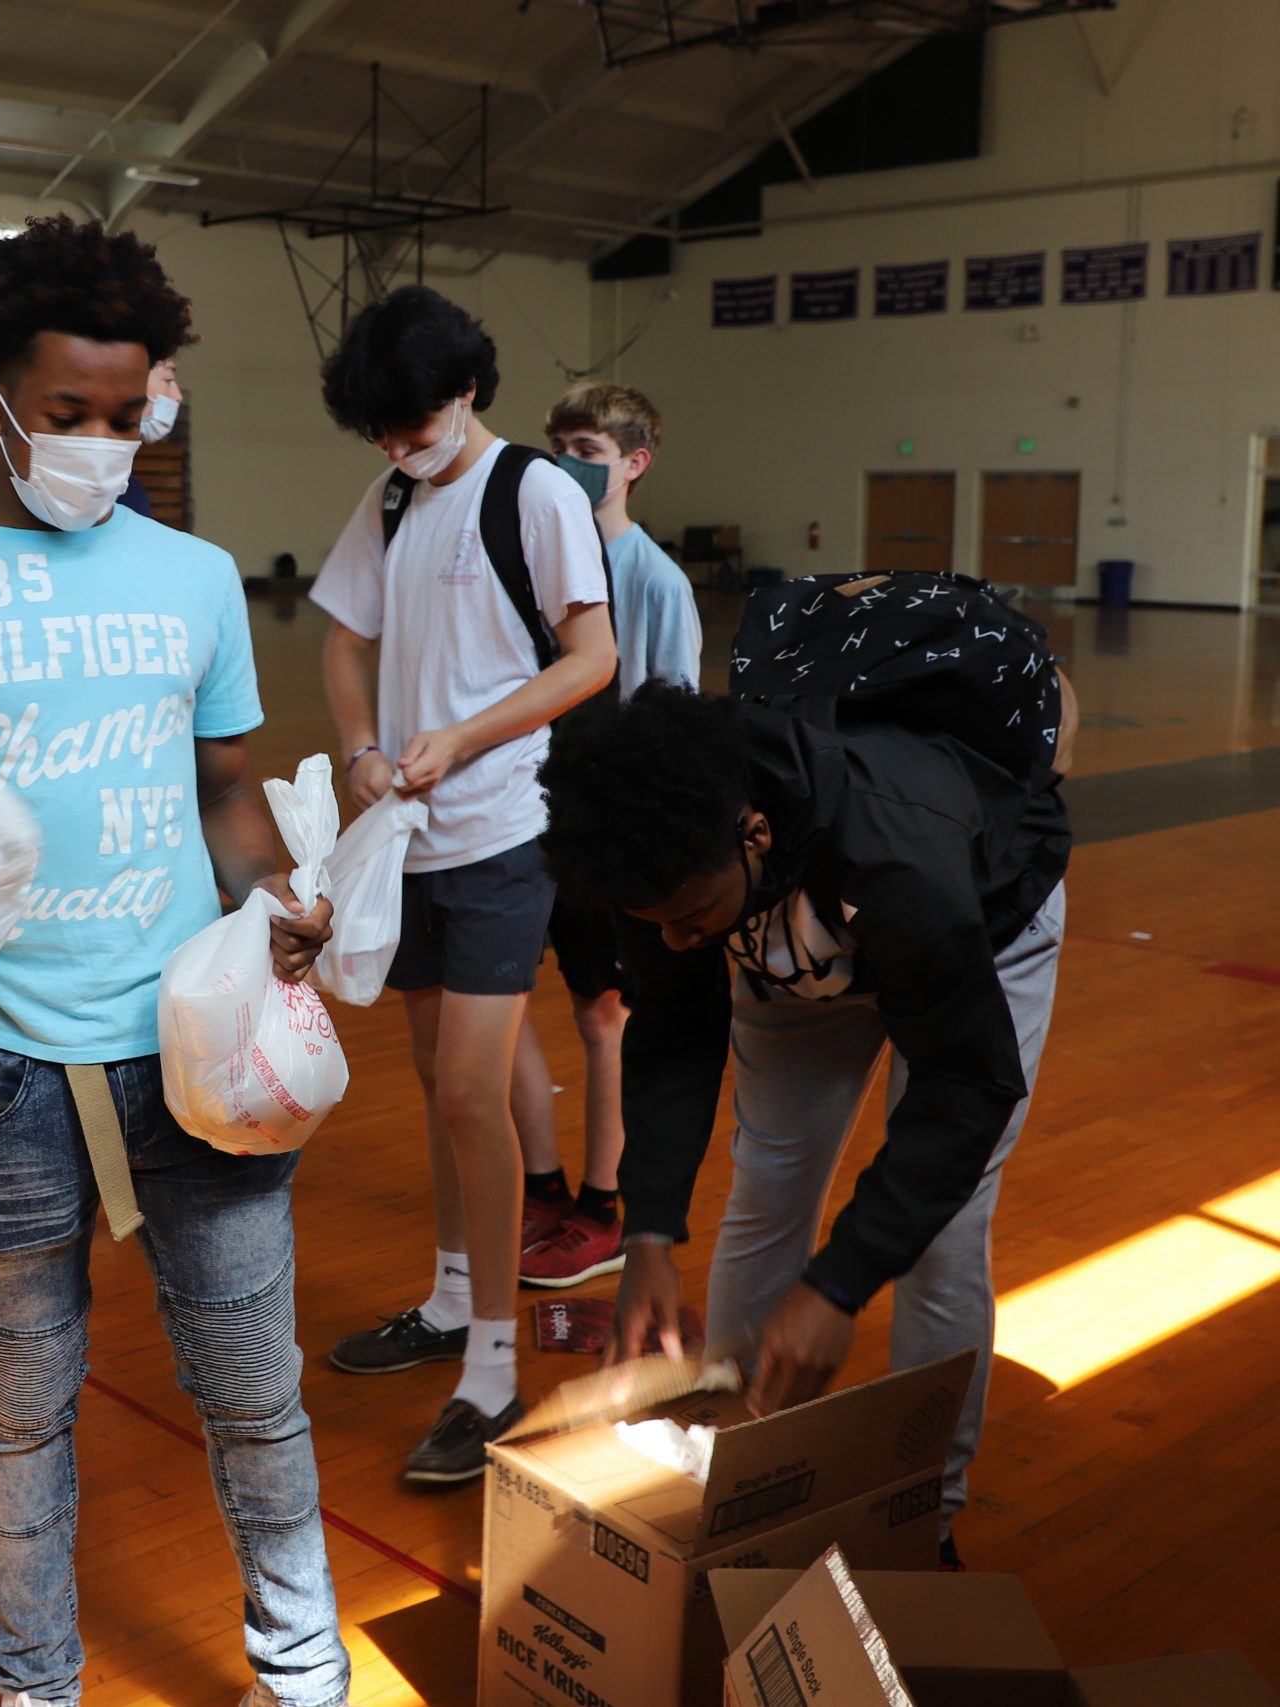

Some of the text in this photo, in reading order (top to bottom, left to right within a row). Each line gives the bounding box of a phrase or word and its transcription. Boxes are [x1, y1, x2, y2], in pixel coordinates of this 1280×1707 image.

[99, 784, 184, 855] NYC
[10, 866, 175, 940] uality
[549, 1303, 572, 1340] Insights 3
[733, 1458, 808, 1493] Single Stock
[891, 1479, 940, 1524] 00596
[595, 1526, 647, 1580] 00596
[534, 1595, 568, 1627] CEREAL
[496, 1626, 538, 1673] RICE
[533, 1623, 588, 1670] Kellogg's
[785, 1620, 823, 1697] Single Stock
